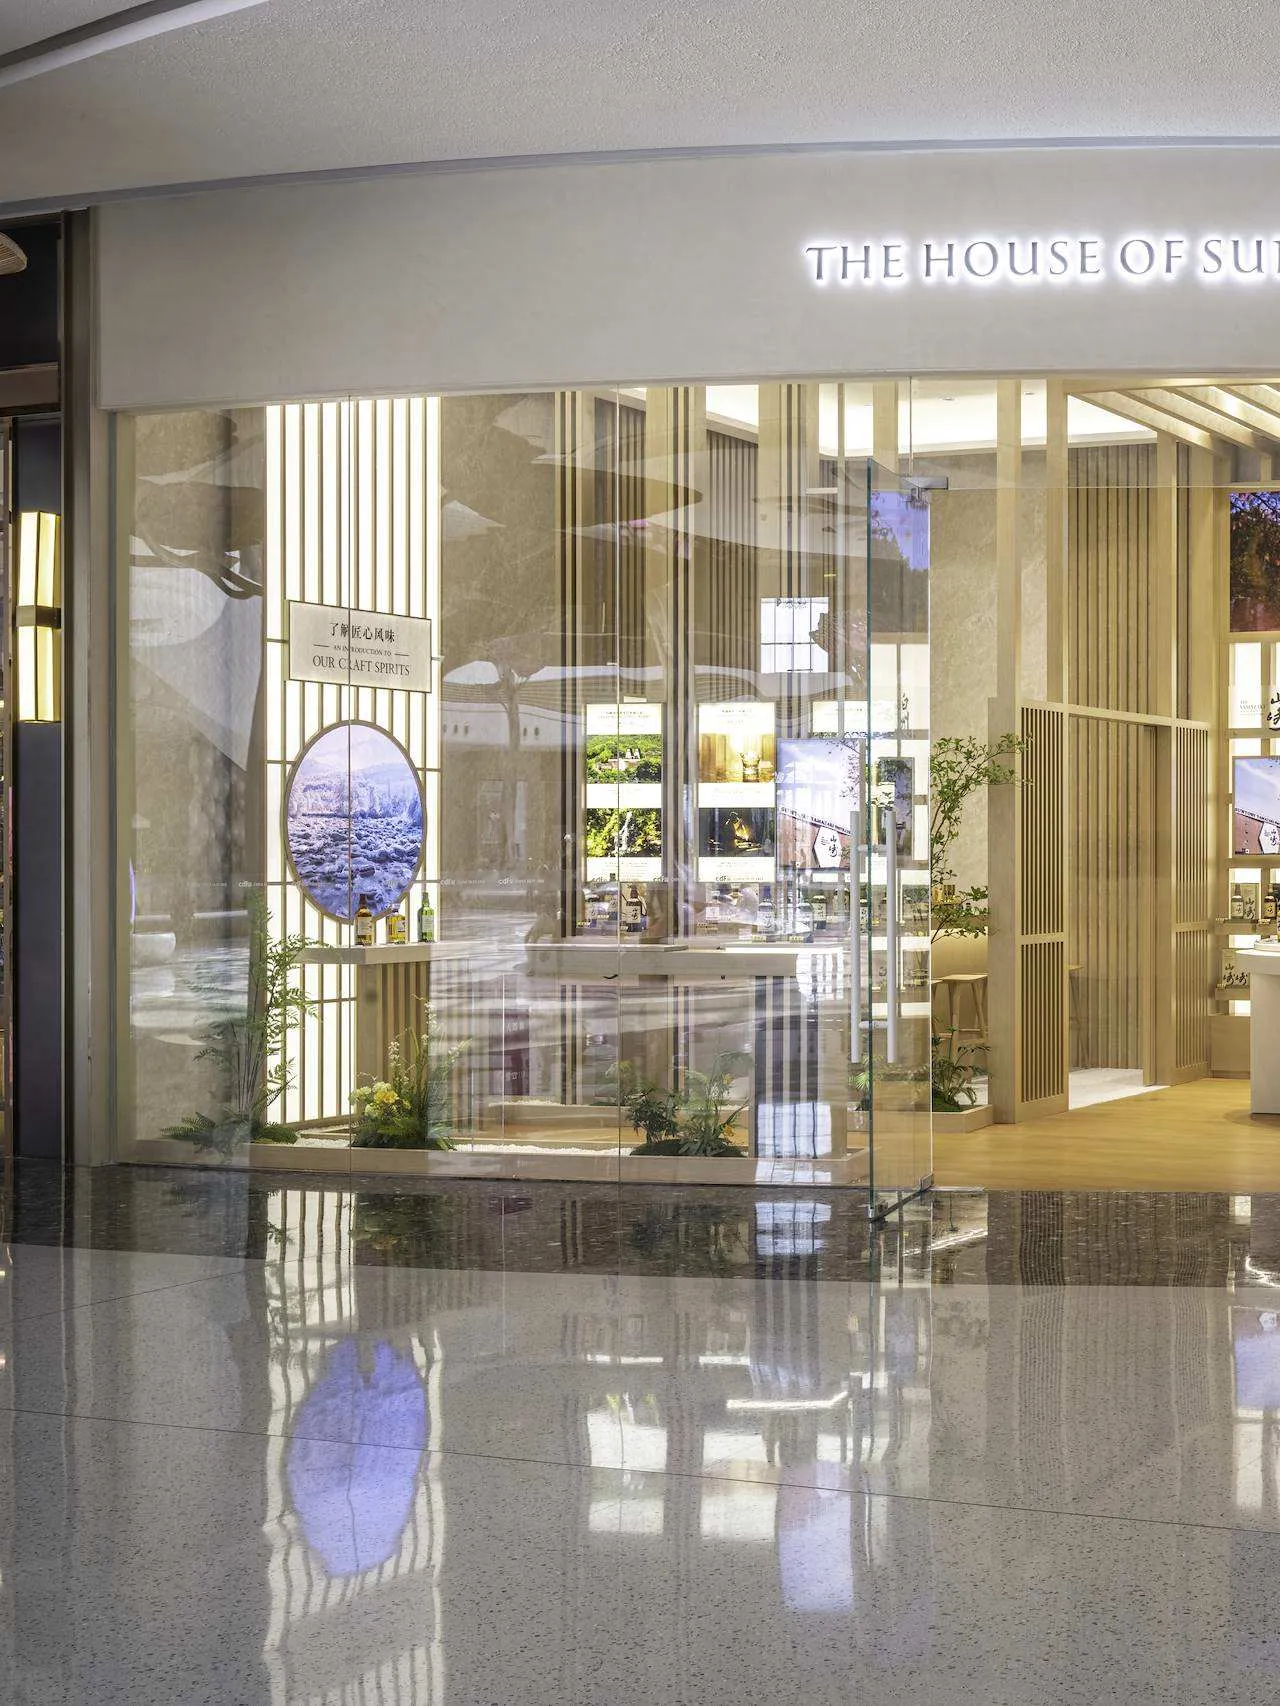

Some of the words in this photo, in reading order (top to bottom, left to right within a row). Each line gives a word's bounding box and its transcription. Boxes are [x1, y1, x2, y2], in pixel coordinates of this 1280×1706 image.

[806, 244, 904, 281] THE
[923, 240, 1100, 278] HOUSE
[1119, 240, 1185, 275] OF
[312, 655, 335, 668] OUR
[338, 657, 372, 672] CRAFT
[374, 661, 410, 676] SPIRITS
